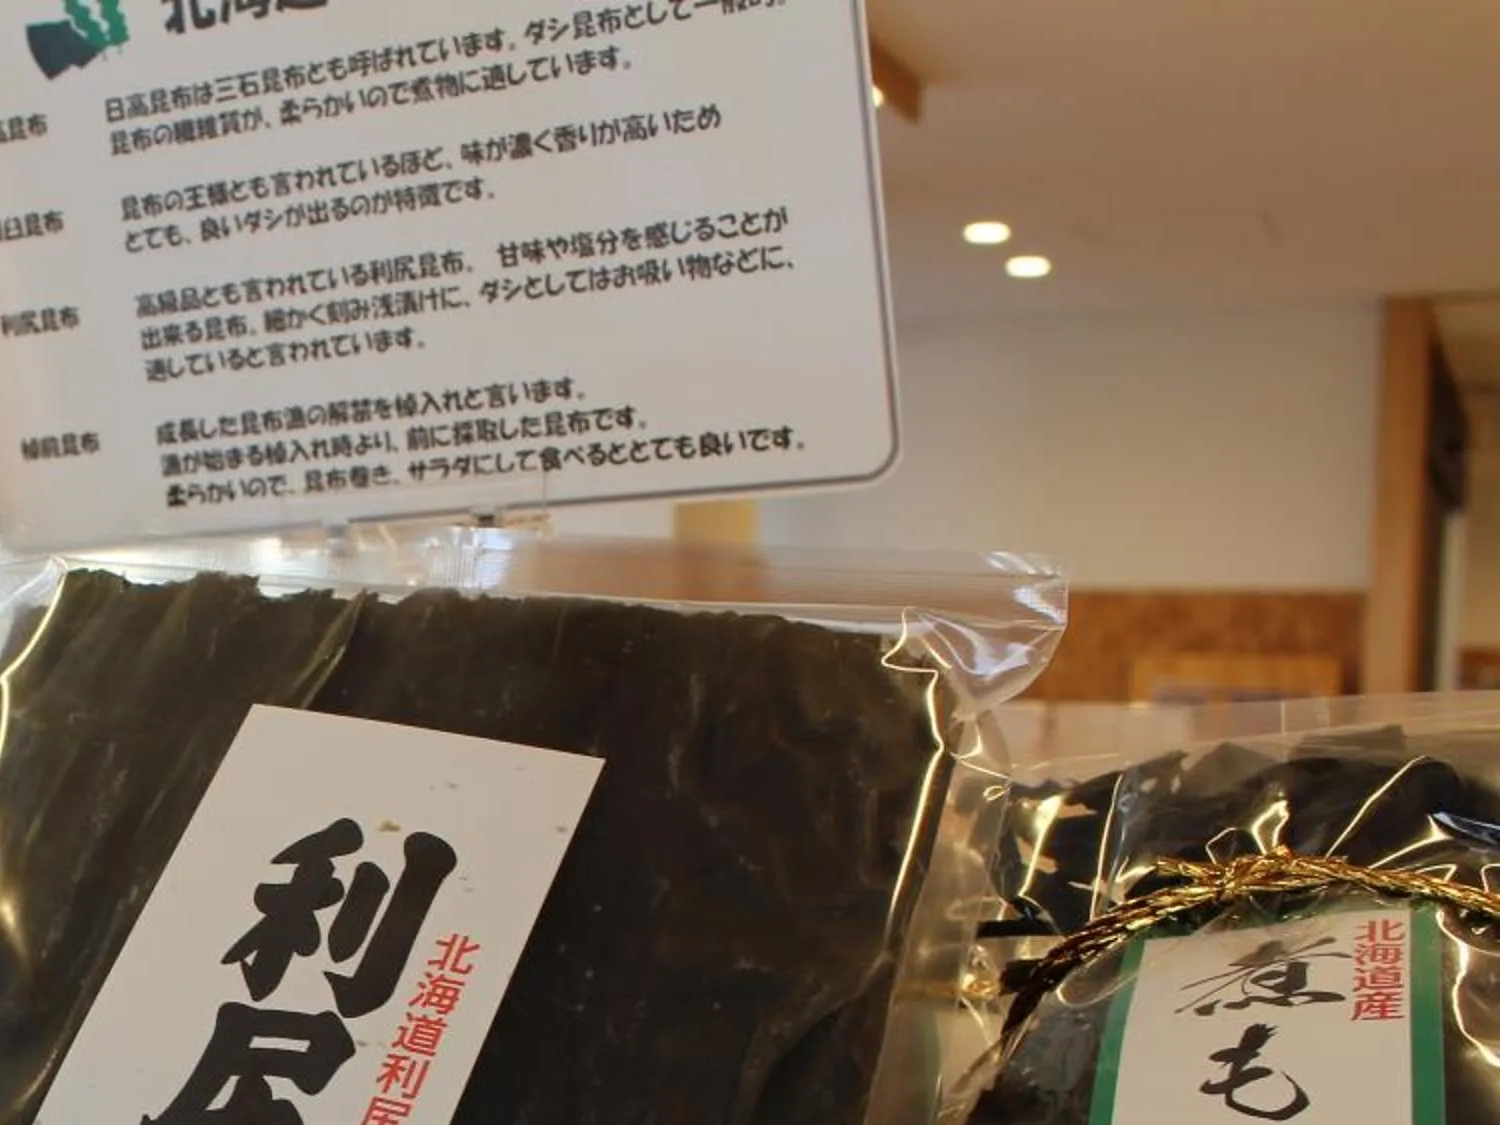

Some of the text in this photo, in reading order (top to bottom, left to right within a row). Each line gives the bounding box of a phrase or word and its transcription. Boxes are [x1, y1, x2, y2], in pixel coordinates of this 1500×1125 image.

[0, 306, 79, 337] 利尻昆布
[1350, 918, 1405, 1022] 北海道産
